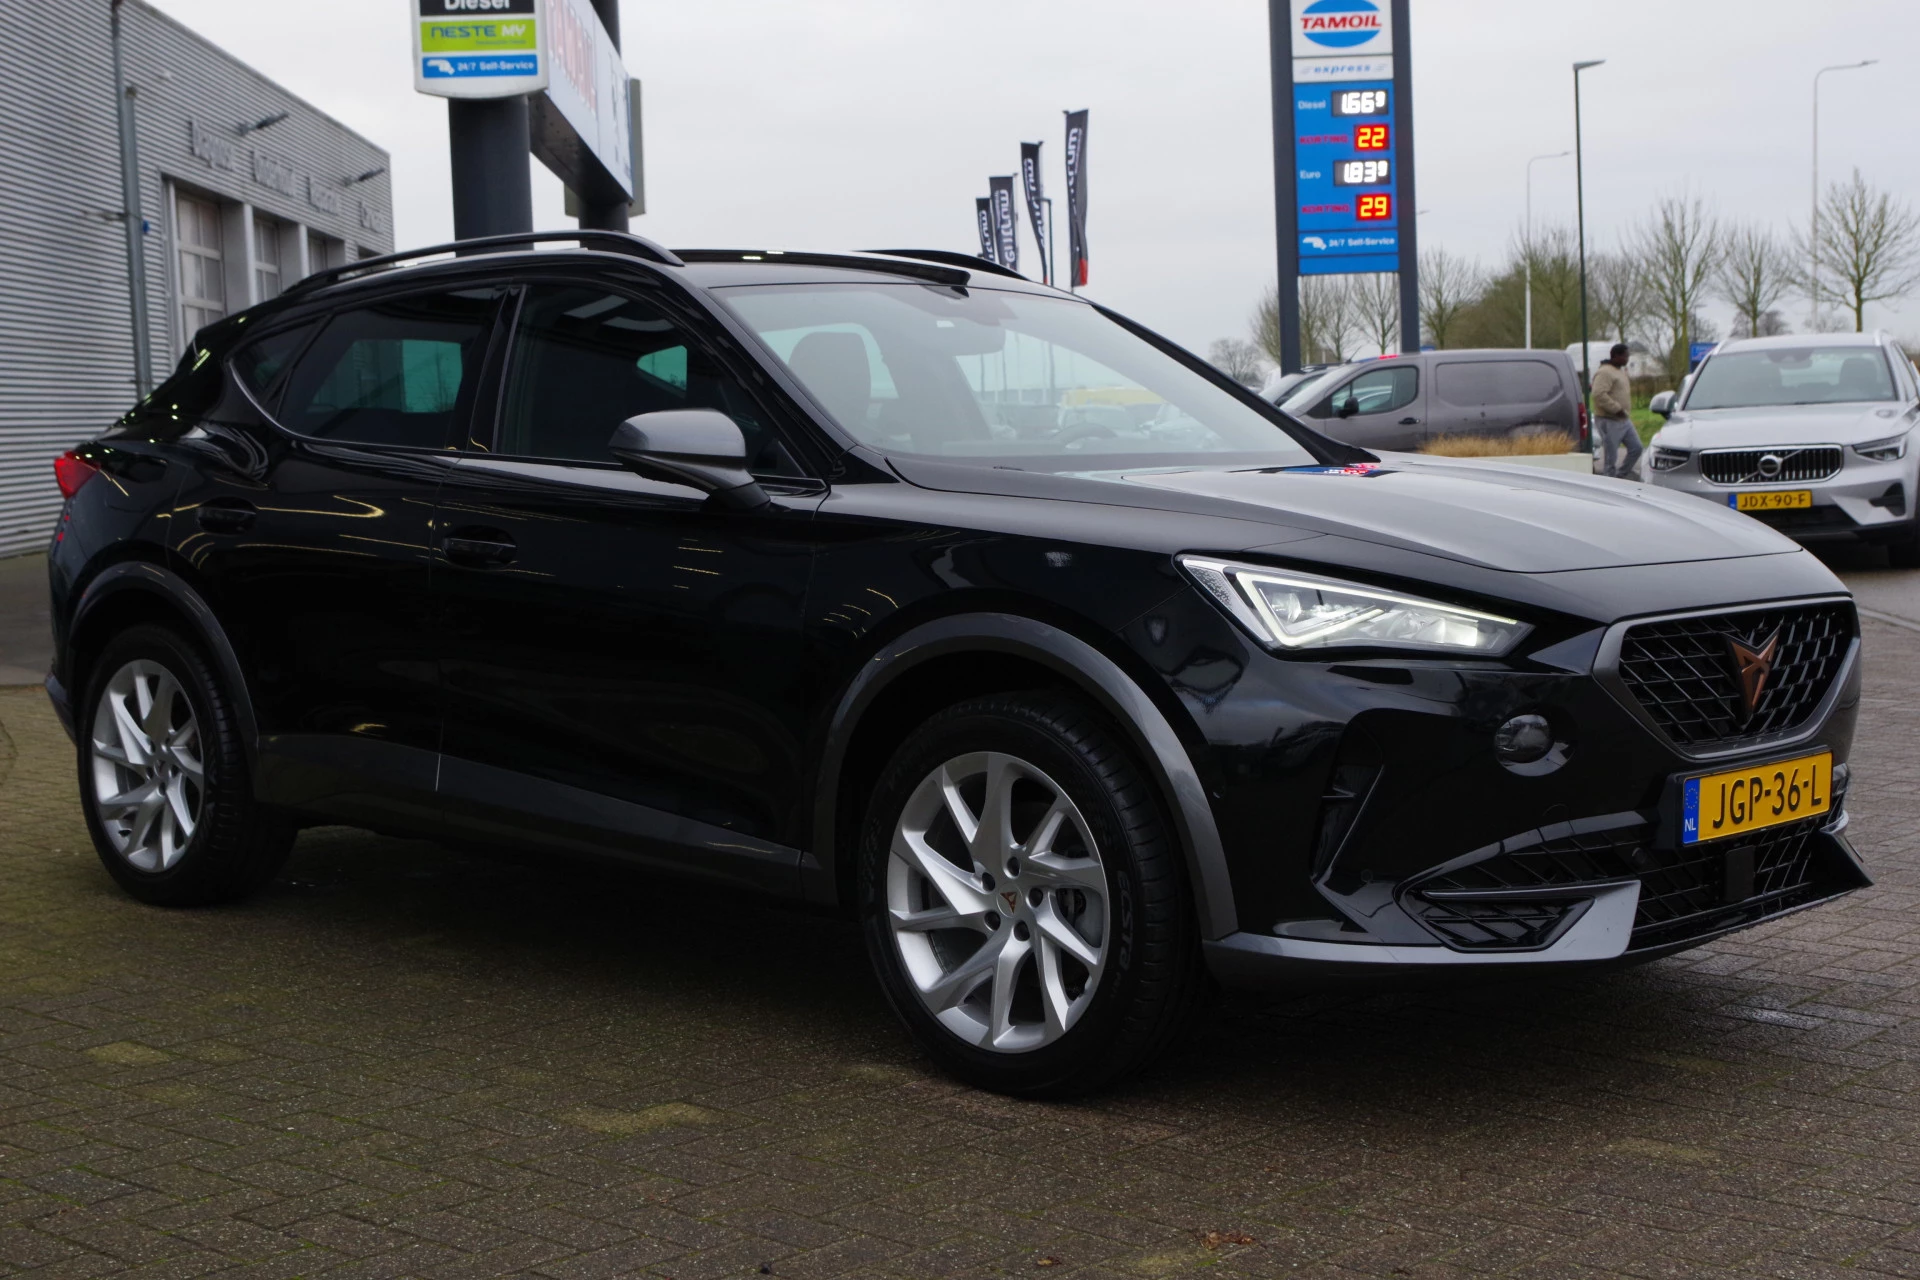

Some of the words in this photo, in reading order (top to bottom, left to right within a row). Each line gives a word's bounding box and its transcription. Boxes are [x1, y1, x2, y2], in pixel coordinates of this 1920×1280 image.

[1300, 13, 1382, 30] TAMOIL
[457, 62, 476, 71] 24/7
[479, 60, 534, 71] Self-Service
[1314, 64, 1371, 75] express
[1298, 100, 1326, 110] Diesel
[1358, 127, 1385, 148] 22
[1300, 170, 1321, 179] Euro
[1360, 196, 1387, 217] 29
[1742, 493, 1806, 508] JDX-90-F
[1712, 764, 1822, 830] JGP-36-L
[1684, 817, 1697, 832] NL
